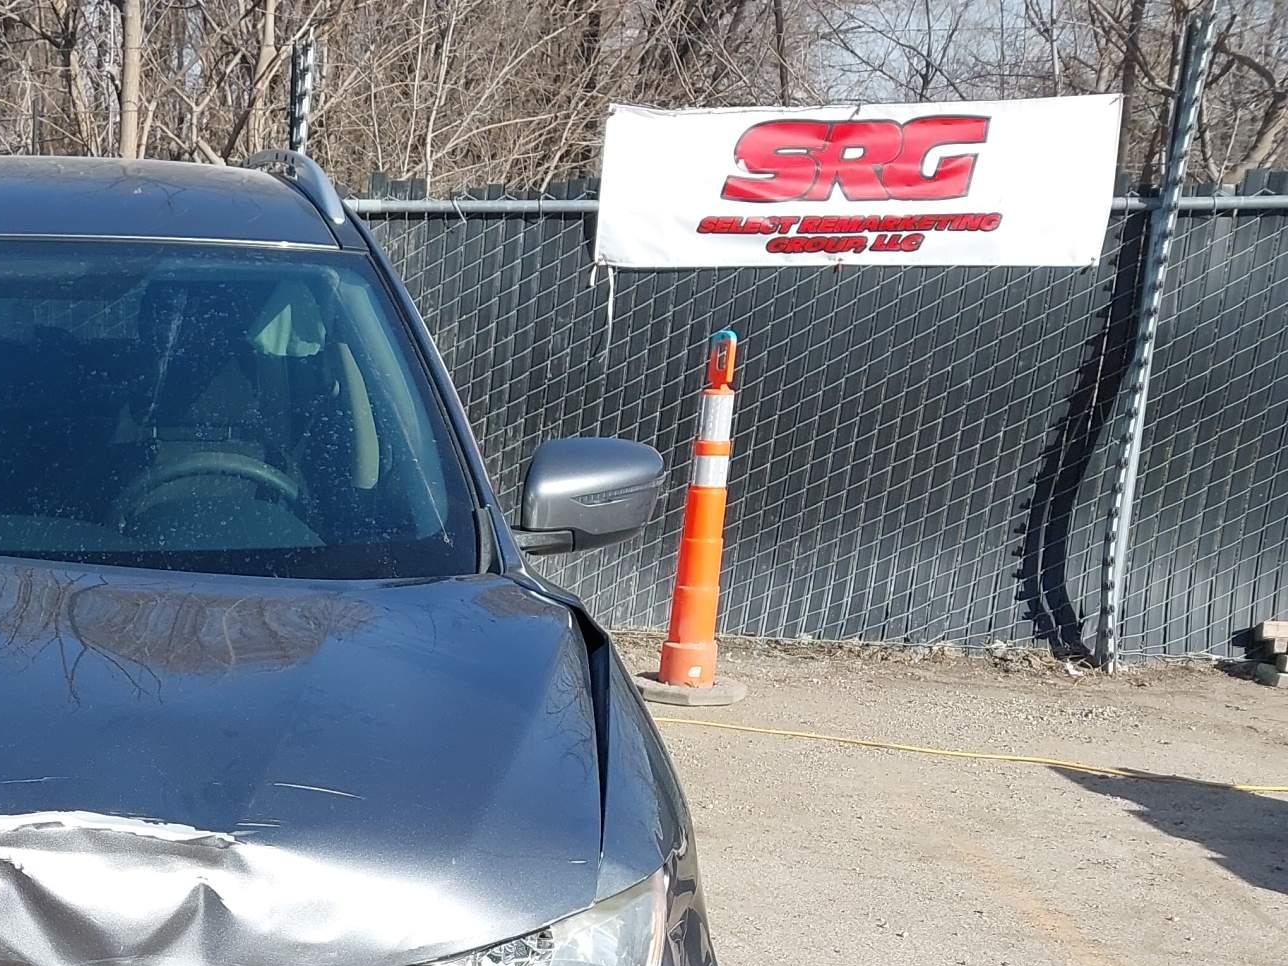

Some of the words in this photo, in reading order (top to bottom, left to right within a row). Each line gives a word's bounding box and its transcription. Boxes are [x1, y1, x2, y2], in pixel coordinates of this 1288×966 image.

[720, 114, 992, 203] SRG
[697, 214, 799, 235] SELECT
[799, 212, 1001, 233] REMARKETING
[765, 233, 867, 255] GROUP,
[869, 232, 925, 253] LLC
